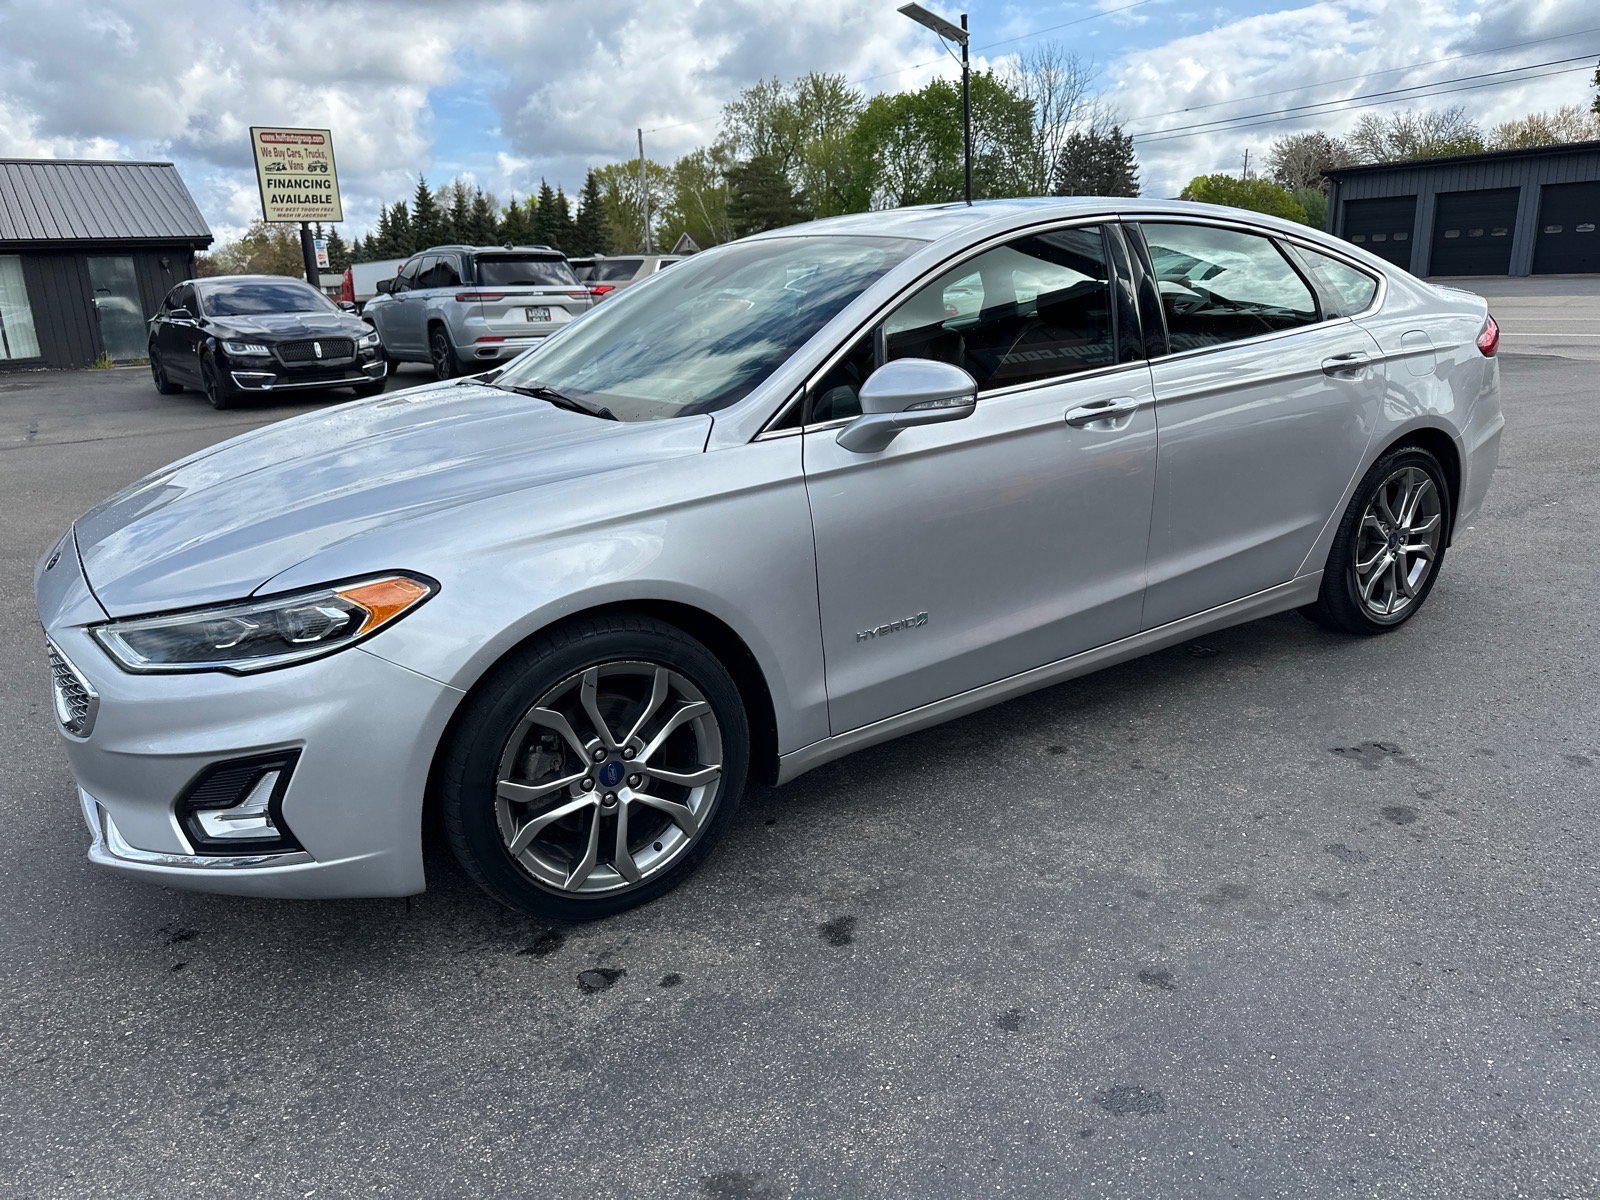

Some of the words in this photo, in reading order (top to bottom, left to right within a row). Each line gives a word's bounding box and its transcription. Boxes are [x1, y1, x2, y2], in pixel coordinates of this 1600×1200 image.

[260, 147, 272, 158] We
[273, 147, 285, 160] Buy
[286, 147, 304, 160] Cars,
[304, 148, 327, 160] Trucks,
[288, 160, 304, 171] Vans
[267, 179, 331, 189] FINANCING
[271, 194, 332, 204] AVAILABLE
[856, 616, 915, 643] HYBRID
